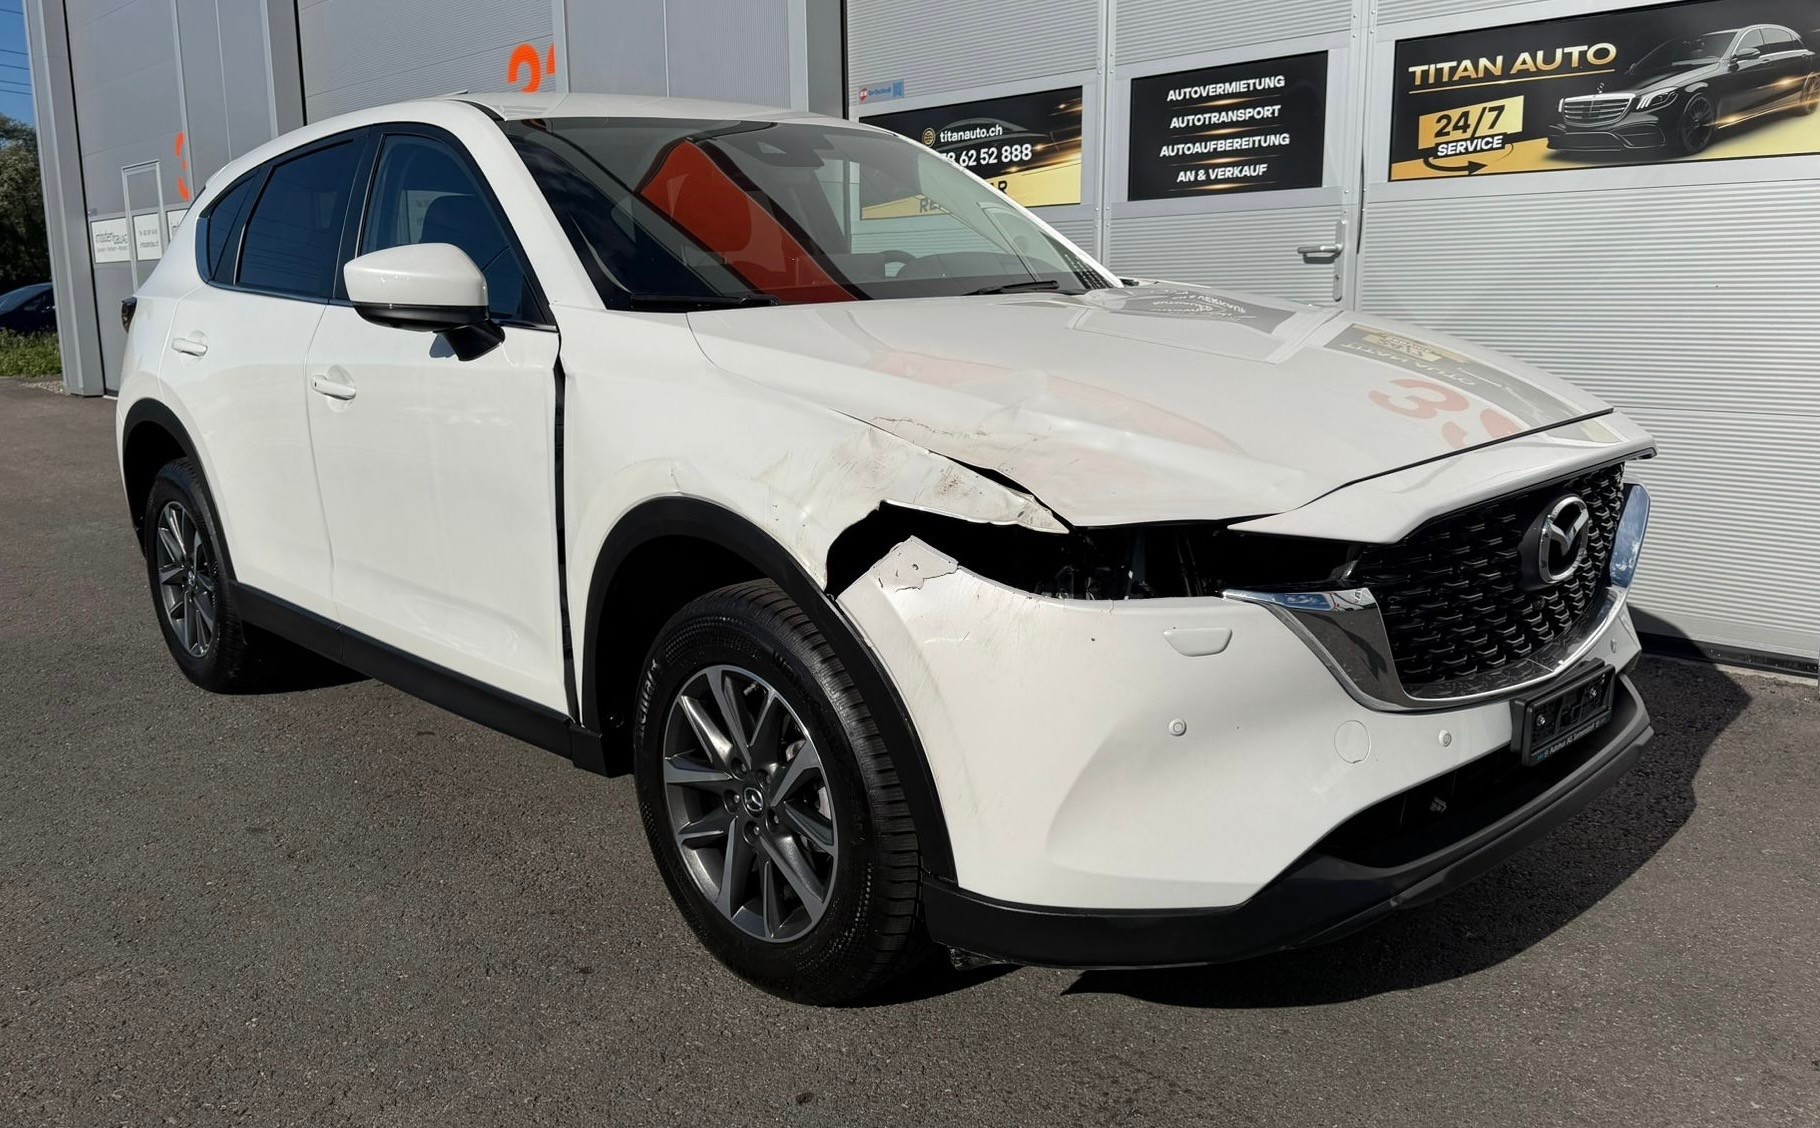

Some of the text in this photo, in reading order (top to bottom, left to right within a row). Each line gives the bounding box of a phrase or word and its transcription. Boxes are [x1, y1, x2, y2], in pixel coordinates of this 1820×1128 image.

[1408, 42, 1617, 86] TITAN AUTO
[1166, 75, 1286, 102] AUTOVERMIETUNG
[1169, 104, 1282, 129] AUTOTRANSPORT
[1434, 105, 1505, 138] 24/7
[939, 124, 1003, 143] titanauto.ch
[1159, 133, 1291, 158] AUTOAUFBEREITUNG
[1437, 135, 1504, 157] SERVICE
[959, 149, 977, 167] 62
[980, 147, 998, 165] 52
[1001, 143, 1033, 163] 888
[1176, 163, 1268, 183] AN & VERKAUF
